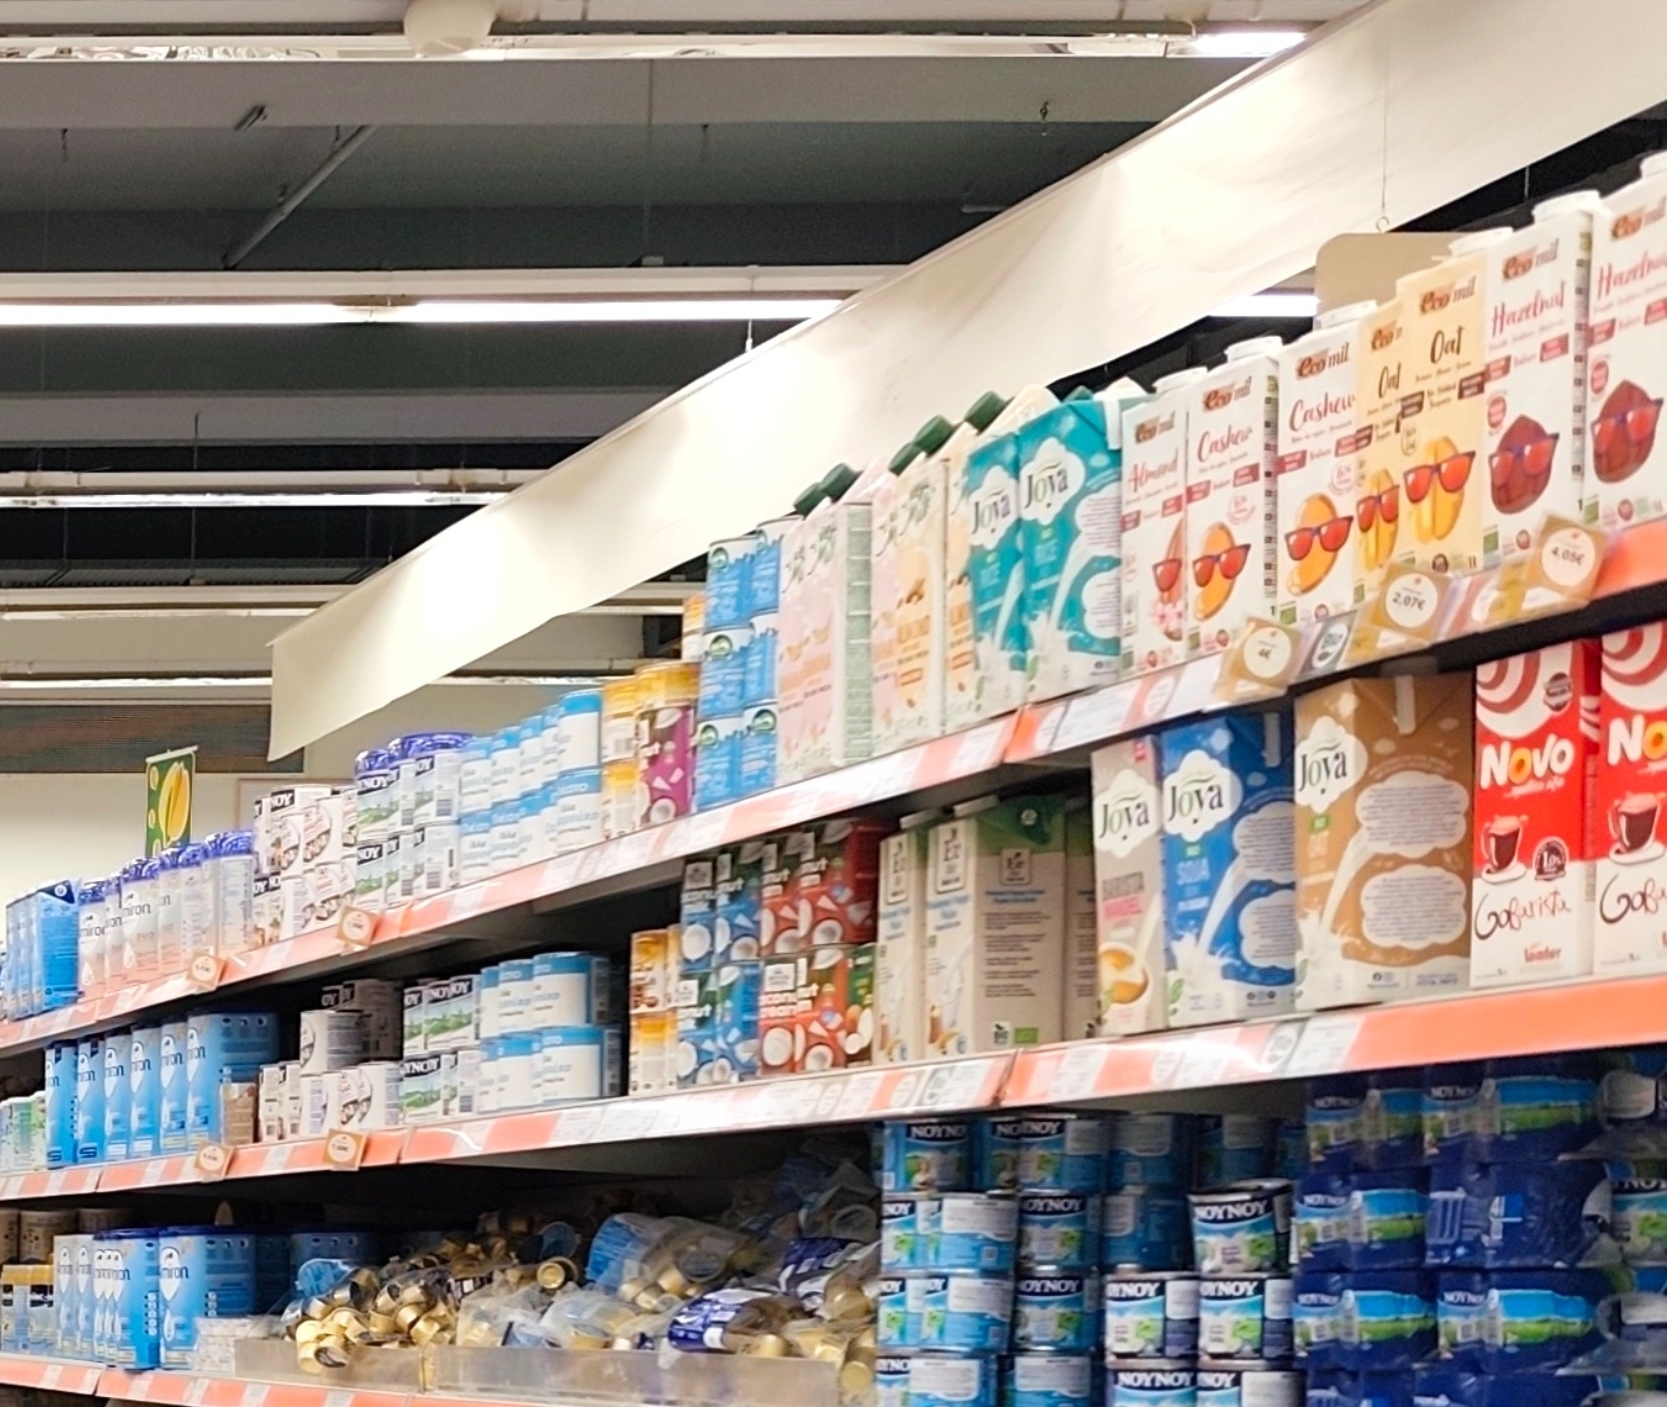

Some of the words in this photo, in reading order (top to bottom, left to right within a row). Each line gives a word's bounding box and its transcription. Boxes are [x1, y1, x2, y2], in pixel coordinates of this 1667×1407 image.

[1492, 281, 1565, 337] Hazelnut
[1431, 326, 1463, 363] Oat
[1023, 462, 1070, 510] Joya
[1300, 749, 1347, 792] Joya
[1101, 797, 1149, 837] Joya
[1167, 777, 1224, 823] Joya
[911, 1123, 965, 1139] NOYNO
[1106, 1281, 1160, 1298] YNOY
[1118, 1371, 1195, 1389] NOYNOY
